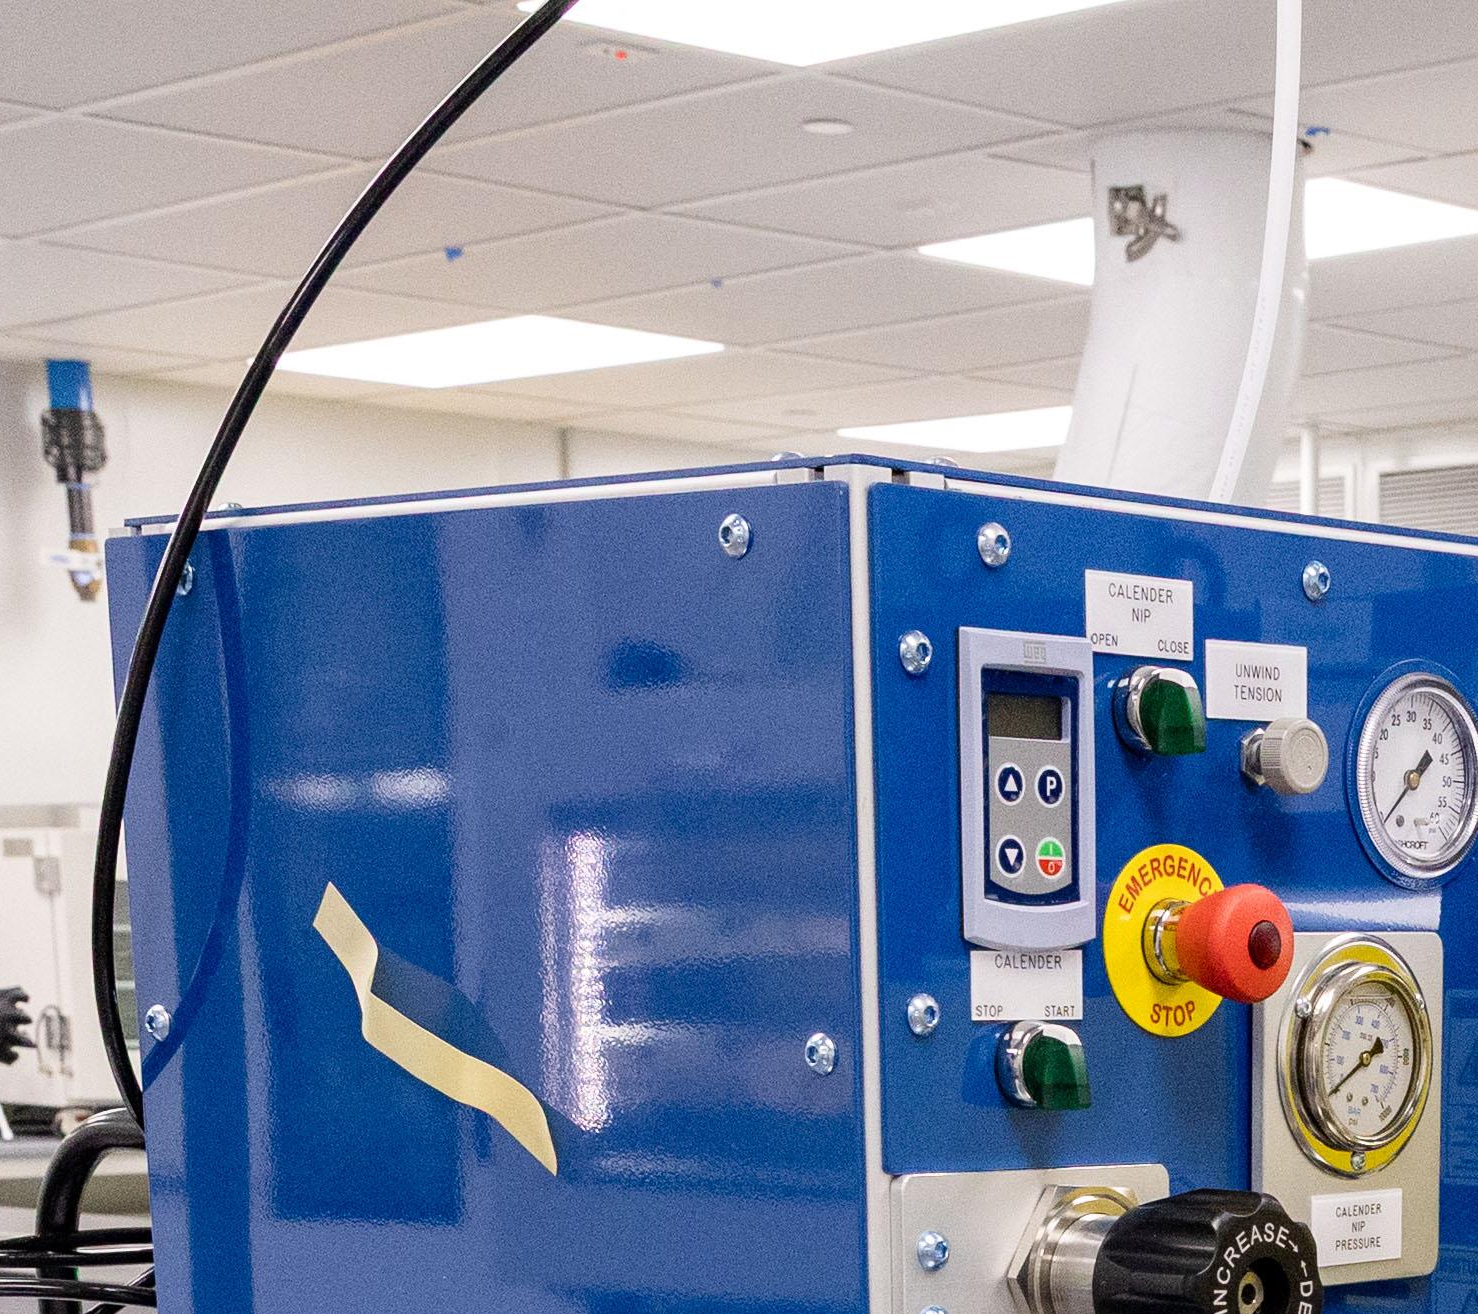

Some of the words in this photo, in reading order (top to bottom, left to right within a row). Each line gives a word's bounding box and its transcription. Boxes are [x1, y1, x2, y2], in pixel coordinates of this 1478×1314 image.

[1108, 582, 1173, 604] CALENDER
[1132, 607, 1151, 623] NIP
[1090, 632, 1118, 647] OPEN
[1157, 639, 1189, 654] CLOSE
[1235, 663, 1280, 681] UNWIND
[1234, 684, 1282, 702] TENSION
[1391, 714, 1401, 727] 25
[1406, 711, 1416, 723] 30
[1422, 718, 1432, 731] 35
[1380, 728, 1388, 741] 20
[1432, 732, 1442, 745] 40
[1439, 754, 1449, 766] 45
[1046, 776, 1057, 796] P
[1442, 775, 1452, 788] 50
[1437, 797, 1447, 809] 55
[1118, 854, 1216, 914] EMERGENC
[994, 954, 1063, 970] CALENDER
[975, 1004, 1004, 1018] STOP
[1044, 1004, 1075, 1018] START
[1150, 1000, 1197, 1027] STOP
[1335, 1203, 1382, 1218] CALENDER
[1351, 1220, 1366, 1233] NIP
[1335, 1236, 1381, 1251] PRESSURE
